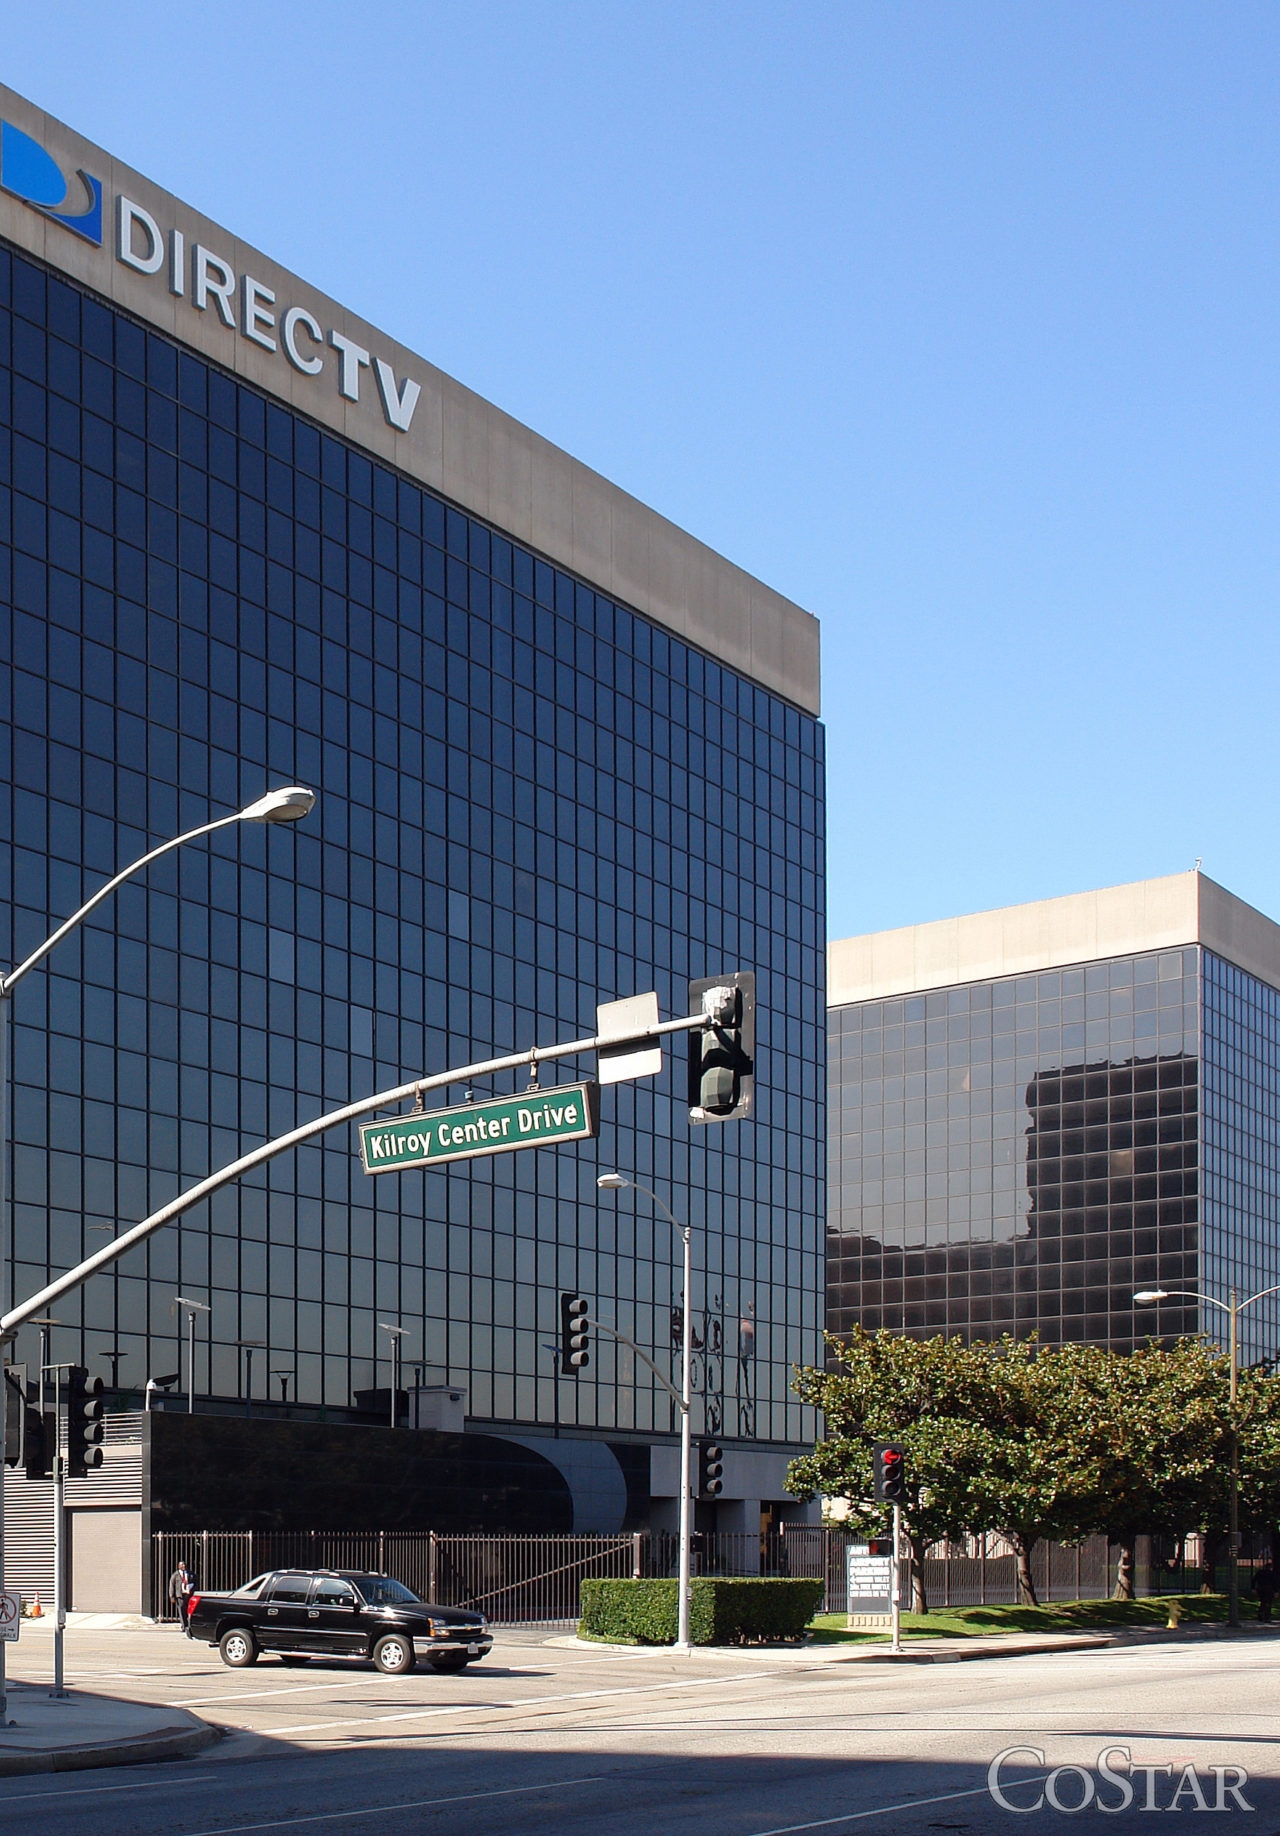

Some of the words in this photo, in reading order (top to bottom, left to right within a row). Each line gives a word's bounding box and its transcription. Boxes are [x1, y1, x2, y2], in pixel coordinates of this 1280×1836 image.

[116, 194, 421, 433] DIRECTV
[370, 1130, 432, 1160] Kilroy
[437, 1115, 511, 1147] Center
[517, 1104, 578, 1133] Drive
